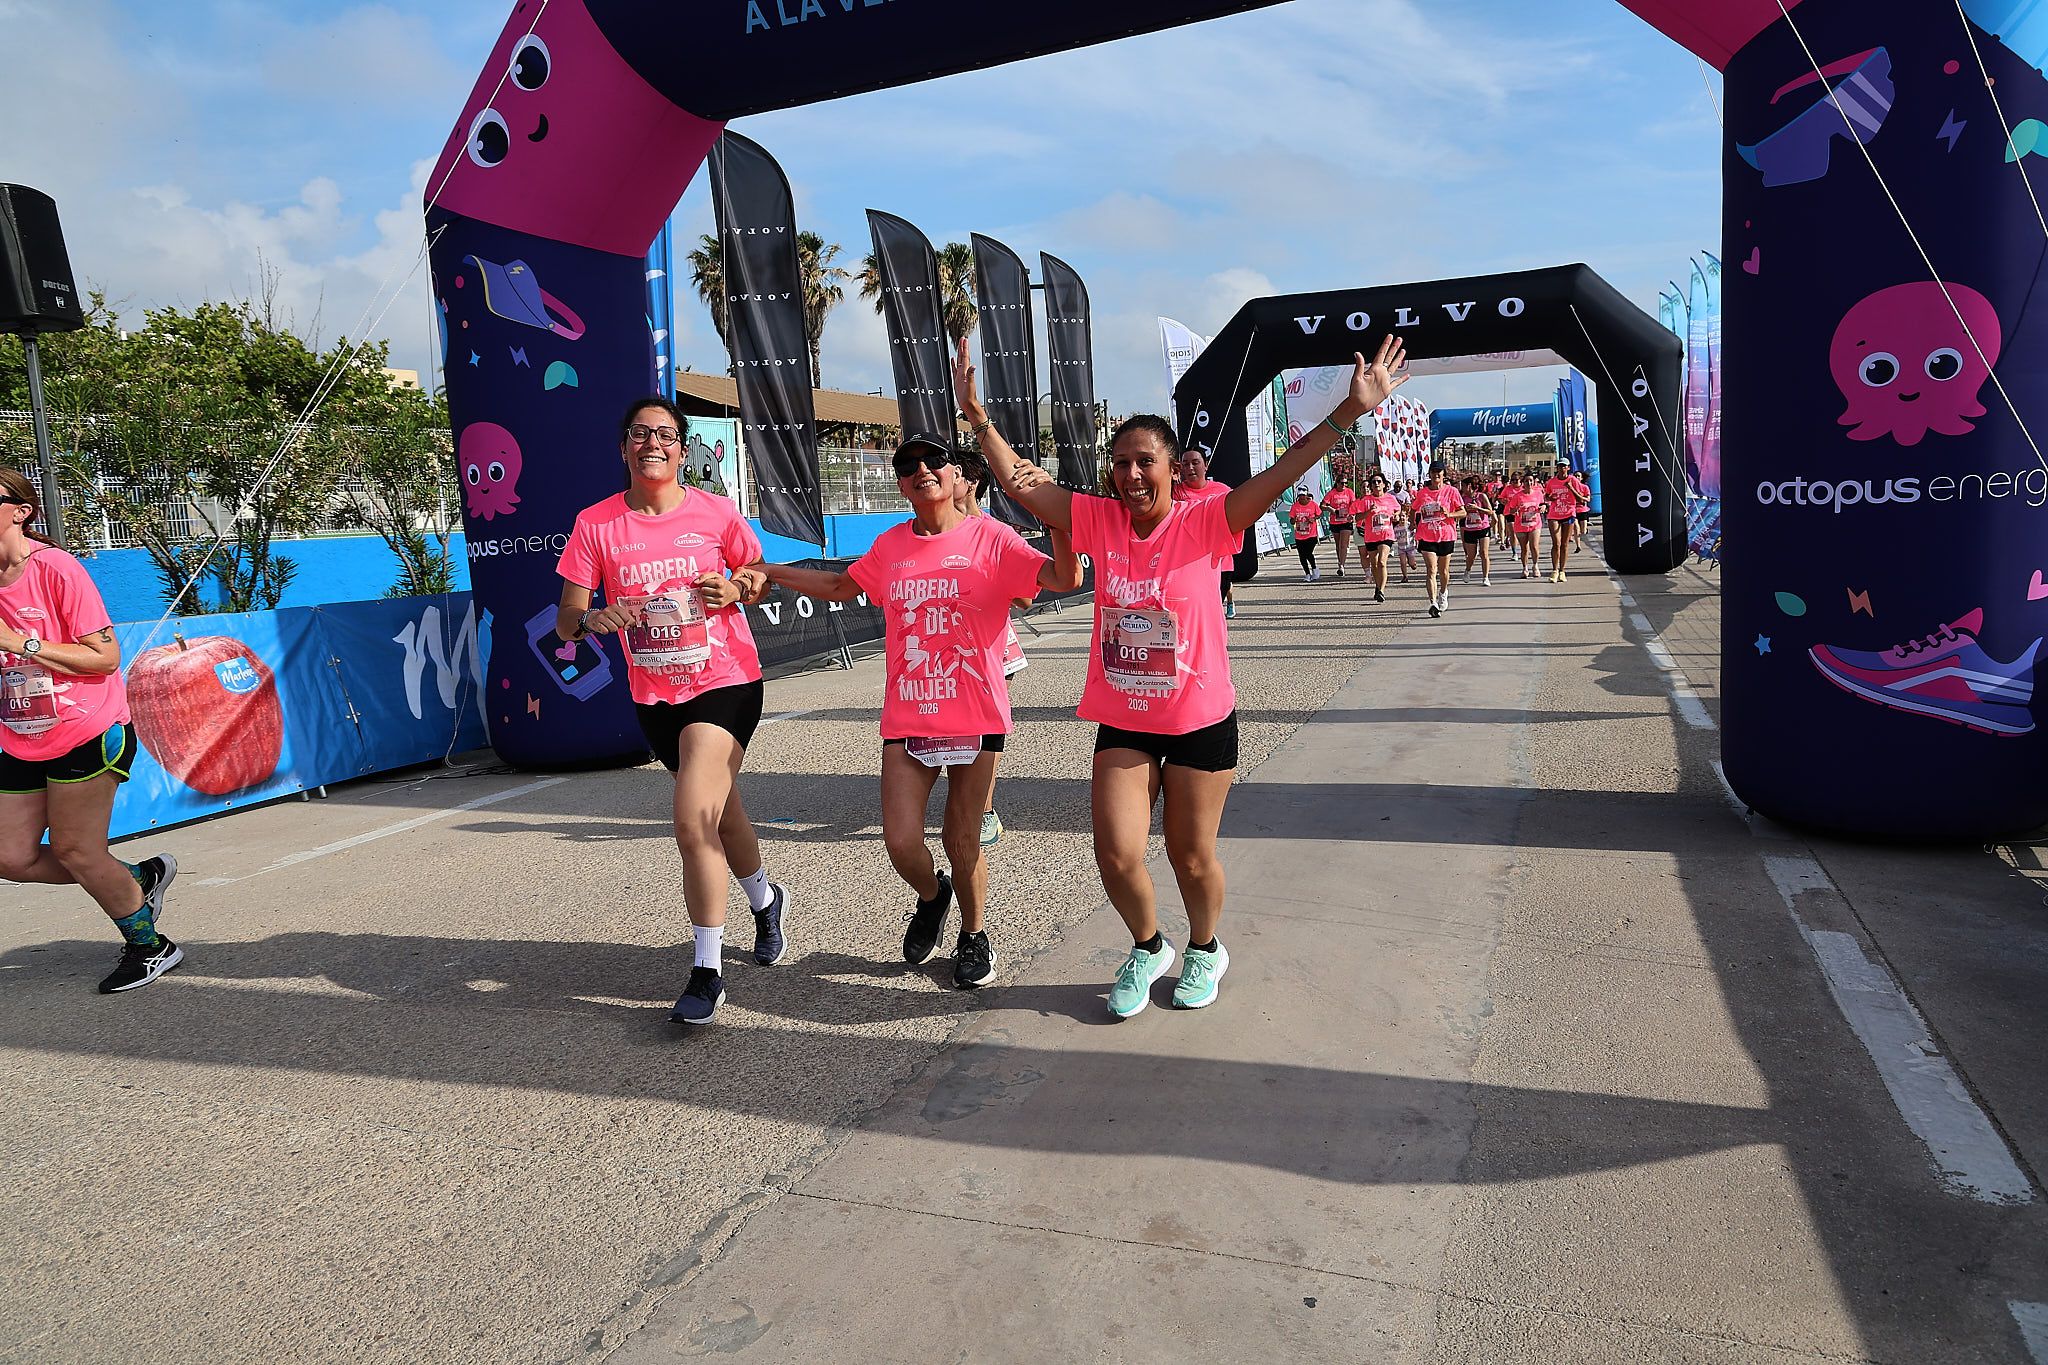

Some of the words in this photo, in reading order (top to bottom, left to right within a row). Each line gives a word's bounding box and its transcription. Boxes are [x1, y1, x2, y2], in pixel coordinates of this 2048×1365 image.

[746, 0, 771, 34] A
[776, 0, 826, 26] LA
[1293, 297, 1525, 335] VOLVO
[1471, 408, 1527, 432] Marlene
[1631, 378, 1654, 548] VOLVO
[1757, 476, 1921, 514] octopus
[1928, 468, 2048, 507] energ
[467, 539, 499, 563] opus
[500, 533, 571, 557] energ
[611, 542, 646, 555] OYSHO
[1107, 551, 1130, 565] OYSH
[619, 555, 699, 588] CARRERA
[889, 578, 960, 602] CARRERA
[759, 591, 868, 626] VOLV
[925, 606, 950, 635] DE
[650, 625, 682, 639] 016
[924, 651, 944, 678] LA
[1119, 645, 1149, 661] 016
[898, 677, 957, 702] MUJER
[9, 697, 32, 710] 016
[918, 702, 939, 715] 2026
[1127, 697, 1149, 712] 2026
